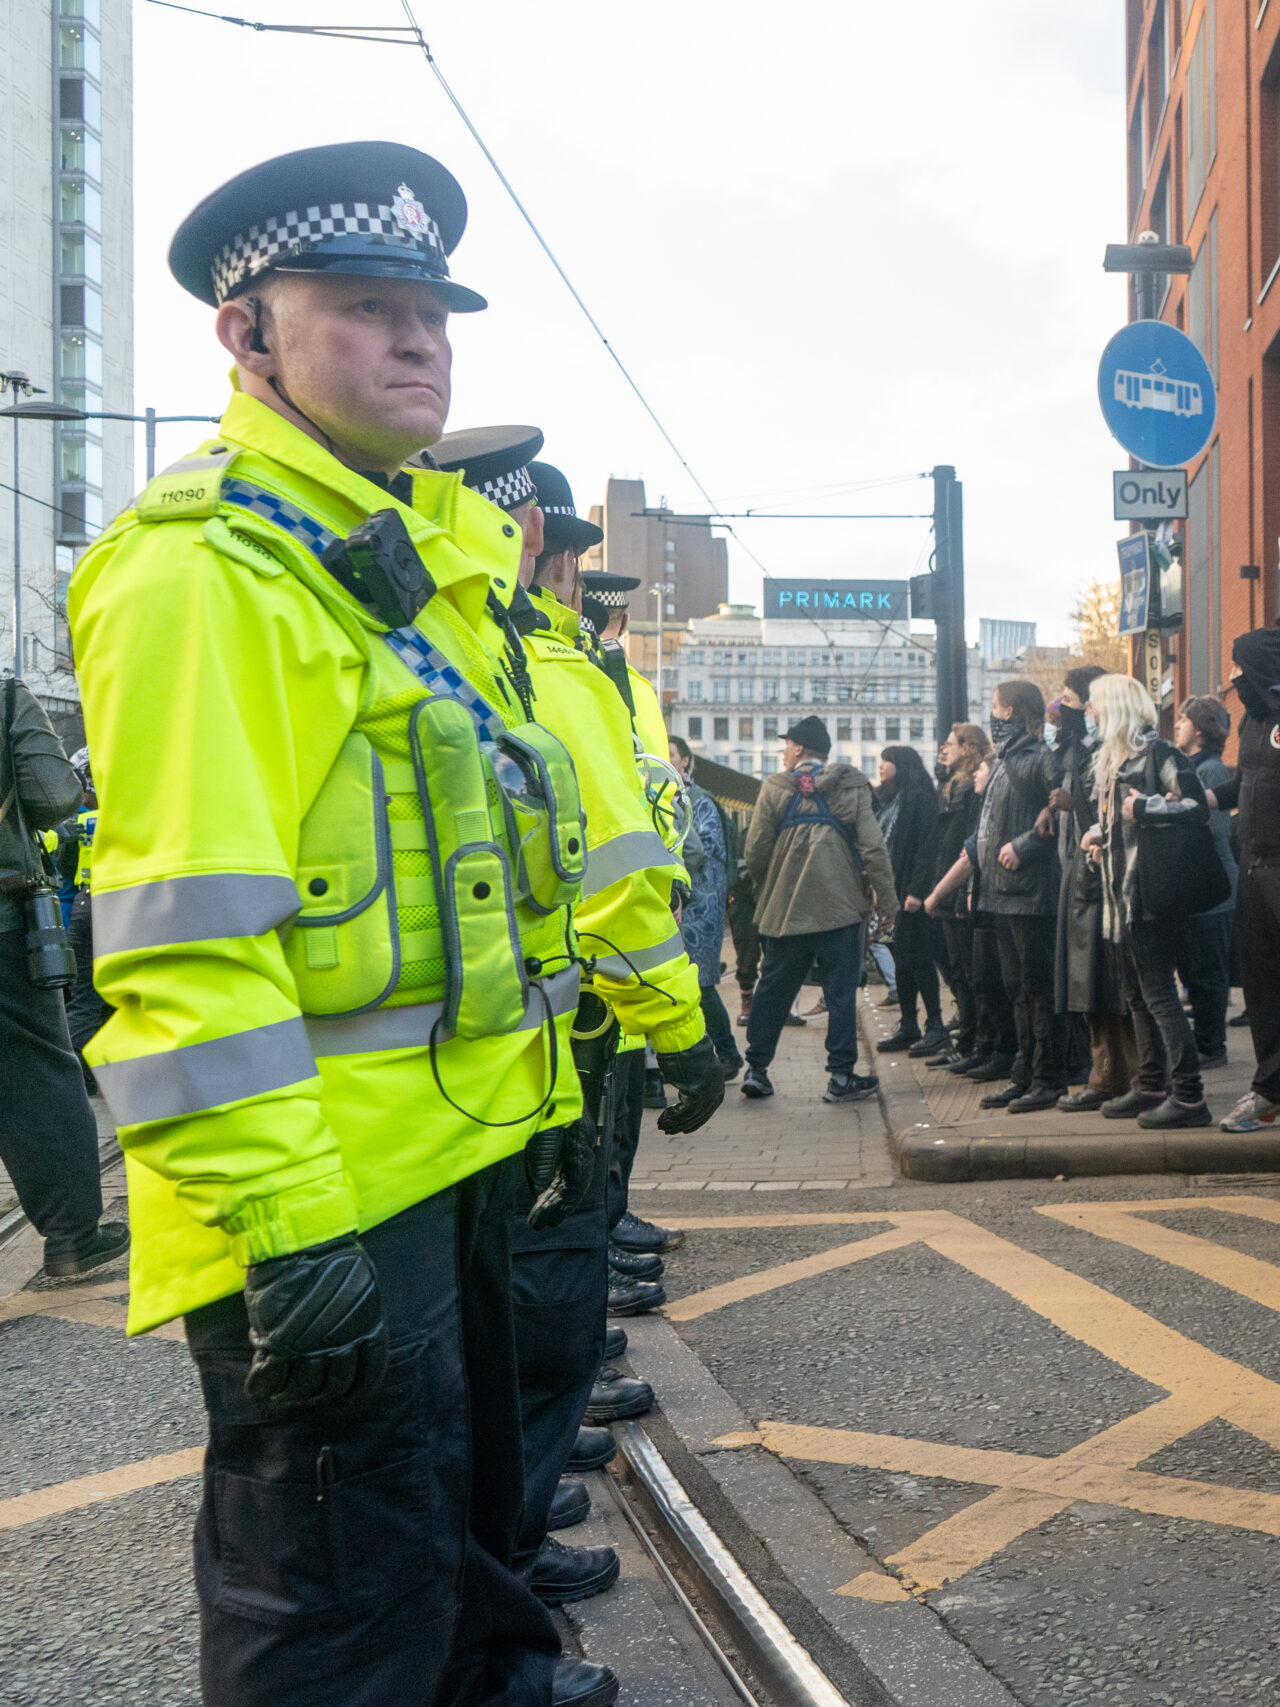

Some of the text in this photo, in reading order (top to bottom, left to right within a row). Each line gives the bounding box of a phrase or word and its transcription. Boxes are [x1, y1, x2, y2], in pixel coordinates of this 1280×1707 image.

[160, 488, 205, 504] 11090
[1120, 481, 1181, 509] Only
[778, 591, 892, 609] PRIMARK
